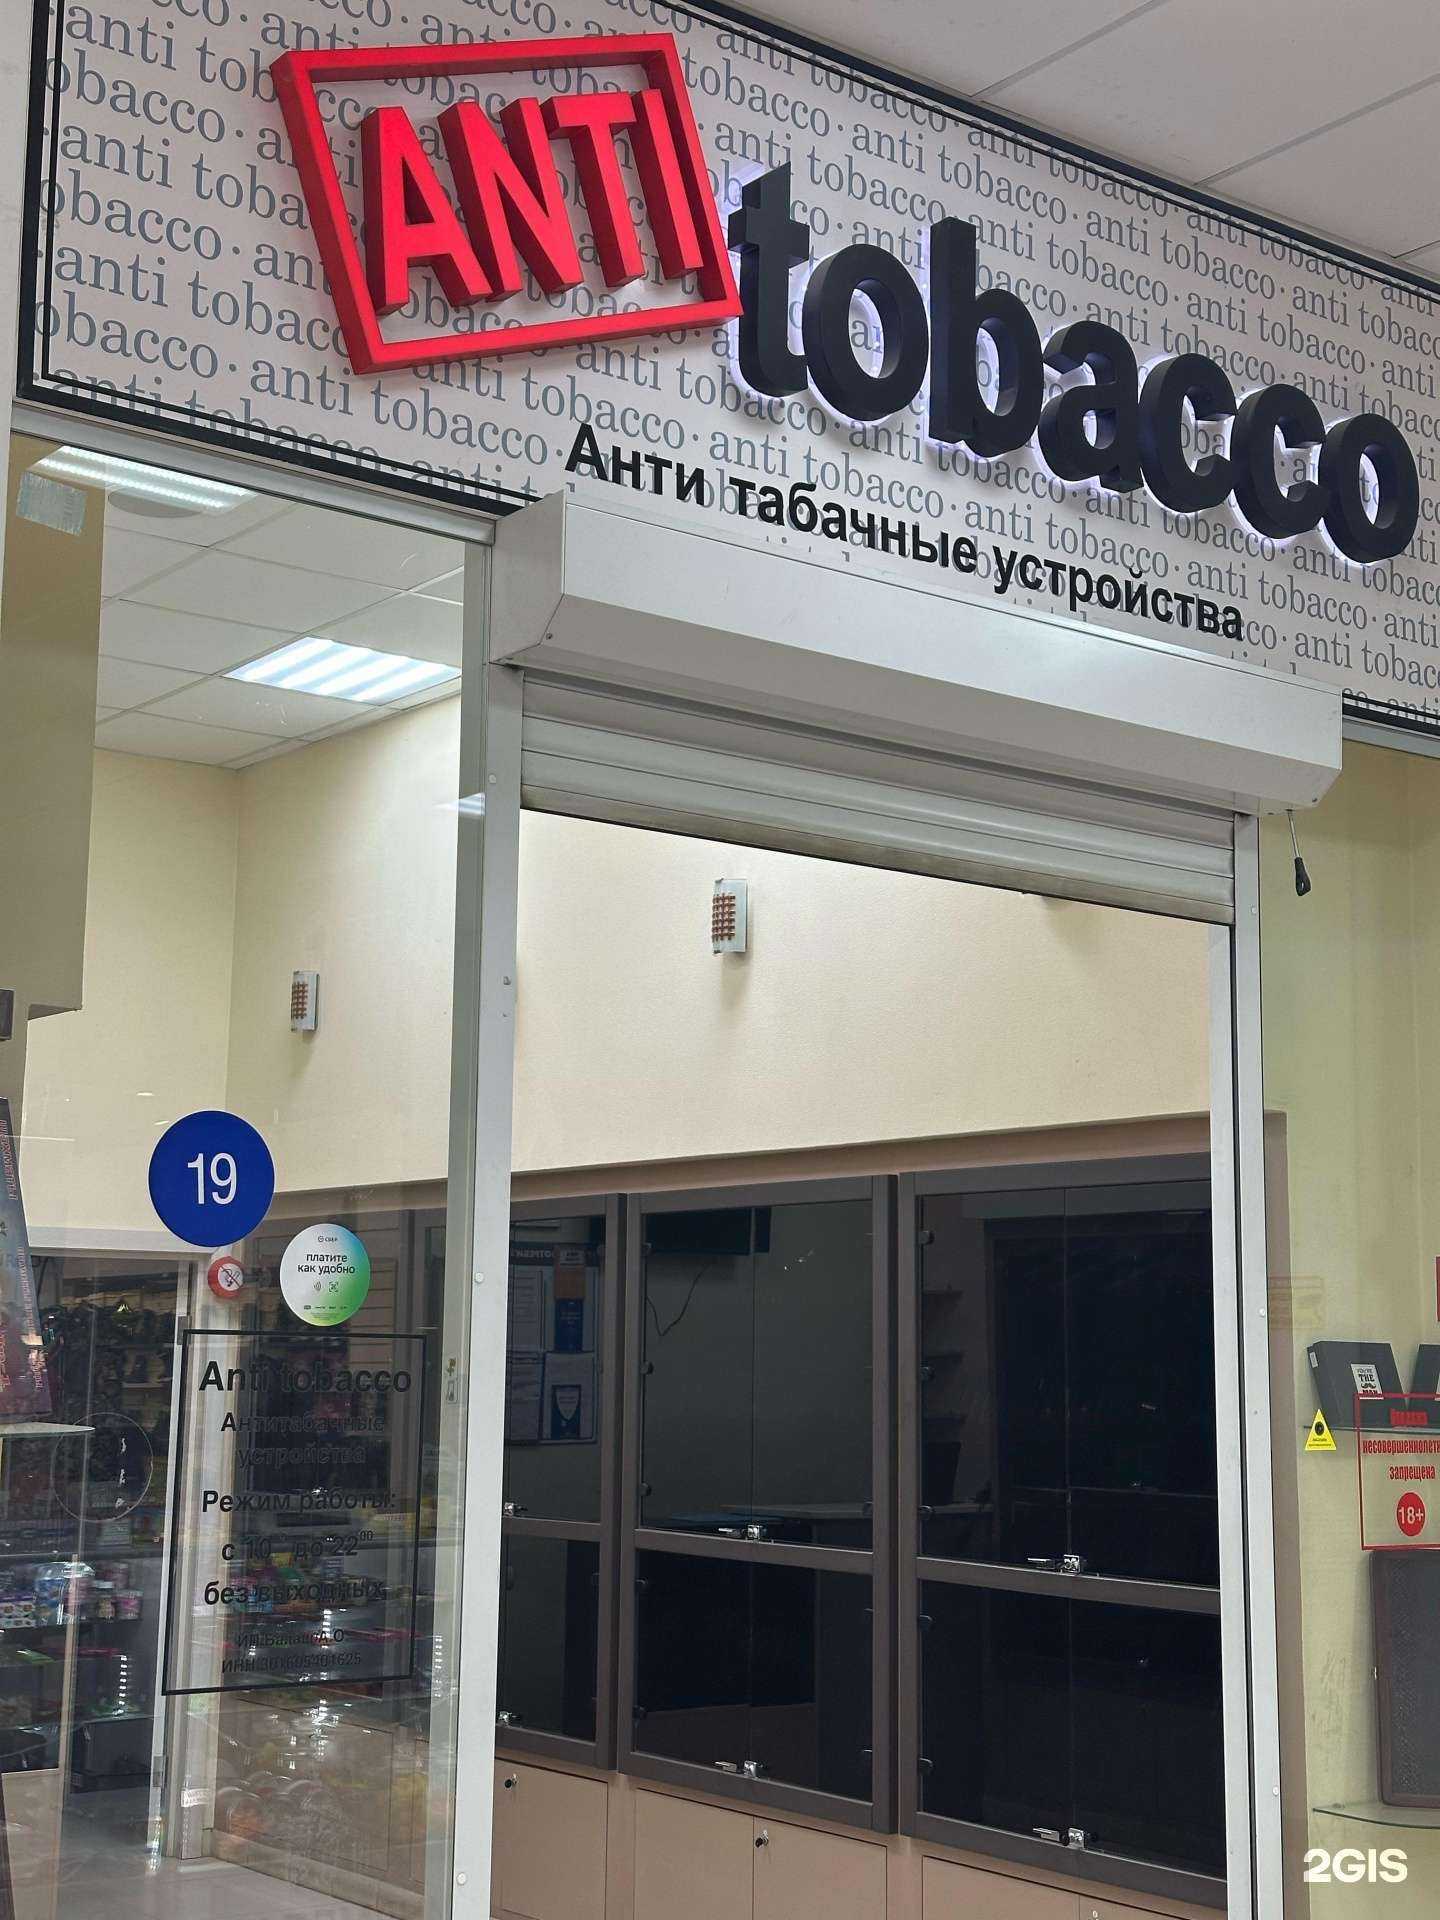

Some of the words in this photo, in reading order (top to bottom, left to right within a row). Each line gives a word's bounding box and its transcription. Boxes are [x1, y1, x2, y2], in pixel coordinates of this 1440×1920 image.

[64, 4, 179, 69] anti
[59, 124, 175, 187] anti
[679, 47, 831, 138] tobacco
[849, 122, 926, 173] anti
[936, 144, 1068, 225] tobacco
[1084, 210, 1150, 255] anti
[1160, 228, 1276, 300] tobacco
[1289, 284, 1348, 326] anti
[805, 144, 948, 229] tobacco
[1046, 232, 1170, 307] tobacco
[1185, 291, 1248, 334] anti
[1256, 306, 1366, 373] tobacco
[1379, 358, 1435, 396] anti
[361, 89, 703, 316] ANTI
[727, 162, 1419, 563] tobacco
[55, 246, 171, 306] anti
[519, 365, 687, 448] tobacco
[707, 429, 790, 477] anti
[802, 444, 946, 519] tobacco
[963, 499, 1035, 543] anti
[1045, 512, 1171, 578] tobacco
[1186, 559, 1249, 599] anti
[1258, 569, 1368, 629] tobacco
[1381, 610, 1438, 646] anti
[572, 337, 661, 389] anti
[674, 356, 828, 436] tobacco
[846, 417, 923, 464] anti
[934, 432, 1067, 504] tobacco
[1083, 485, 1150, 527] anti
[1160, 497, 1277, 561] tobacco
[246, 358, 352, 415] anti
[367, 378, 548, 465] tobacco
[1291, 631, 1351, 668] anti
[565, 422, 706, 506] Анти
[729, 475, 978, 573] табачные
[992, 544, 1244, 641] устройства
[187, 1152, 238, 1205] 19
[297, 1264, 316, 1273] как
[318, 1263, 356, 1275] удобно
[306, 1253, 348, 1263] платите
[201, 1490, 291, 1513] Режим
[1389, 1465, 1436, 1481] запрещена
[1398, 1506, 1424, 1525] 18+
[203, 1580, 250, 1605] без
